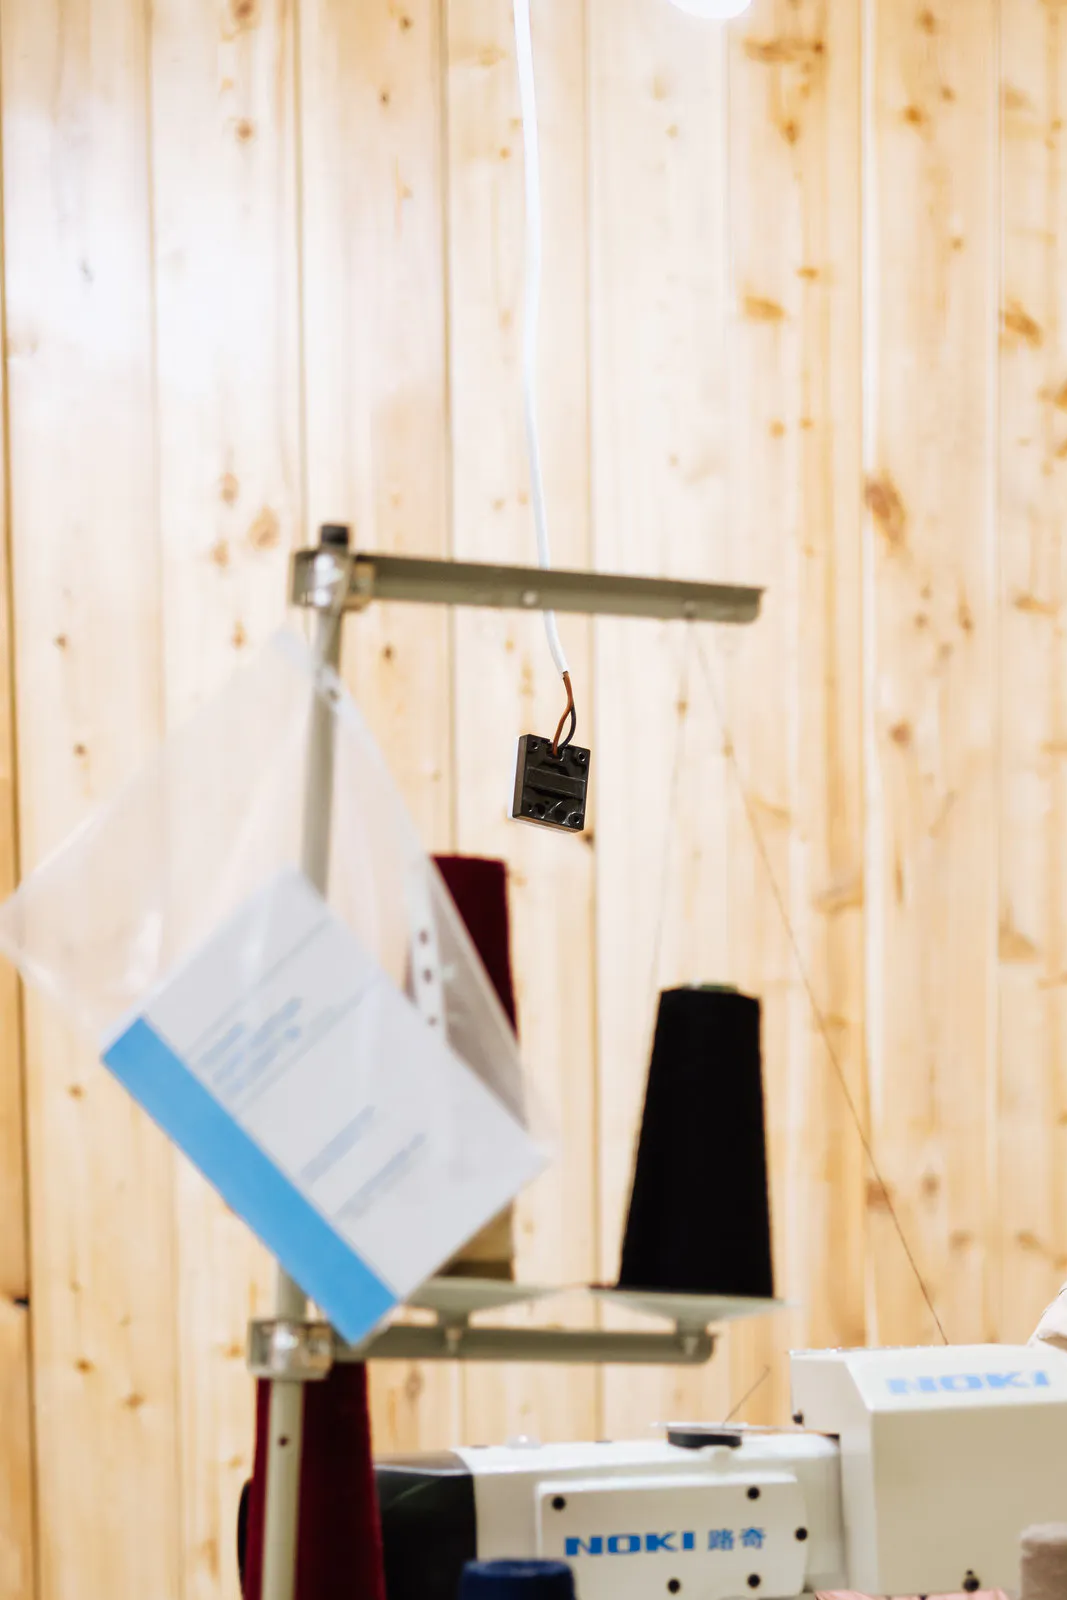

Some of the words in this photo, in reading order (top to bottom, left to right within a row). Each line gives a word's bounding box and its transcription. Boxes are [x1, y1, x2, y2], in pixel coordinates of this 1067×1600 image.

[886, 1370, 1051, 1395] NOKI
[564, 1531, 696, 1557] NOKI
[707, 1526, 766, 1551] 路奇
